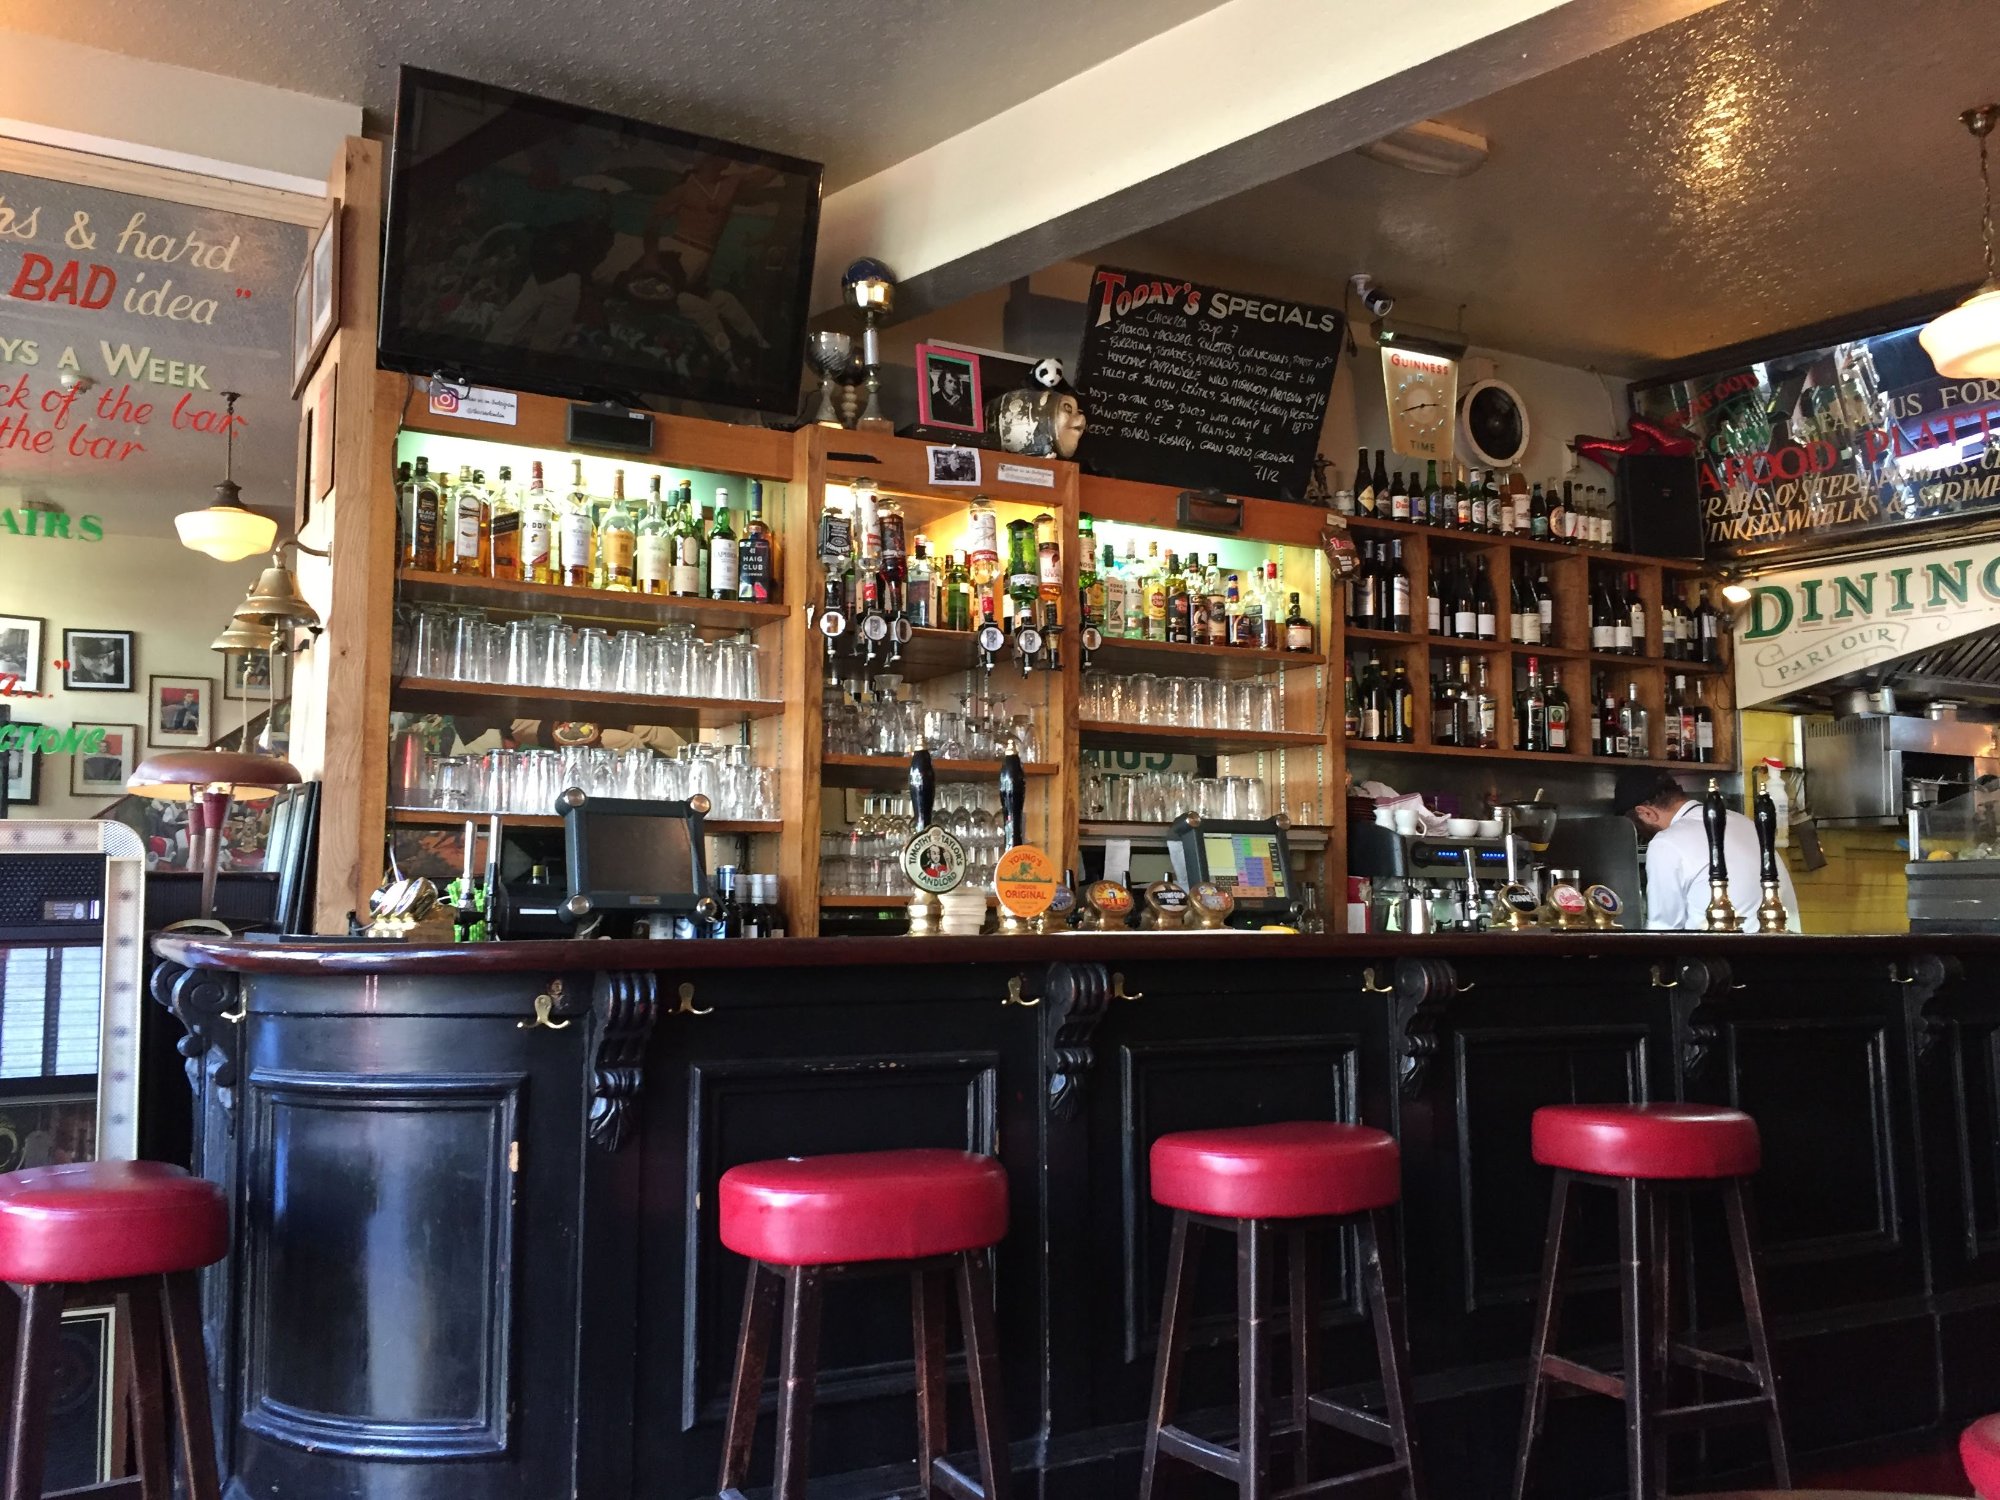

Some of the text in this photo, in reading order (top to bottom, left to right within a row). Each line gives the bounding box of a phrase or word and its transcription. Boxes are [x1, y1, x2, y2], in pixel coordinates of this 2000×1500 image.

[64, 210, 97, 250] &
[116, 212, 240, 273] hard
[8, 252, 118, 311] BAD
[123, 272, 218, 325] idea
[1095, 272, 1335, 333] TODAY'S SPECIALS
[1231, 324, 1239, 338] 7
[57, 346, 81, 371] A
[100, 340, 211, 391] WEEK
[1127, 372, 1140, 382] OF
[1391, 354, 1449, 375] GUINNESS
[41, 384, 84, 430] of
[98, 384, 154, 426] the
[1938, 378, 2000, 410] FOR
[1144, 412, 1164, 426] PIE
[68, 424, 147, 461] bar
[1409, 440, 1436, 452] TIME
[1776, 626, 1898, 680] PARLOUR
[909, 835, 932, 865] TIMOTHY
[941, 834, 963, 867] TAYLOR'S
[1008, 853, 1042, 867] YOUNG'S
[918, 871, 957, 887] LANDLORD
[1005, 889, 1047, 900] ORIGINAL
